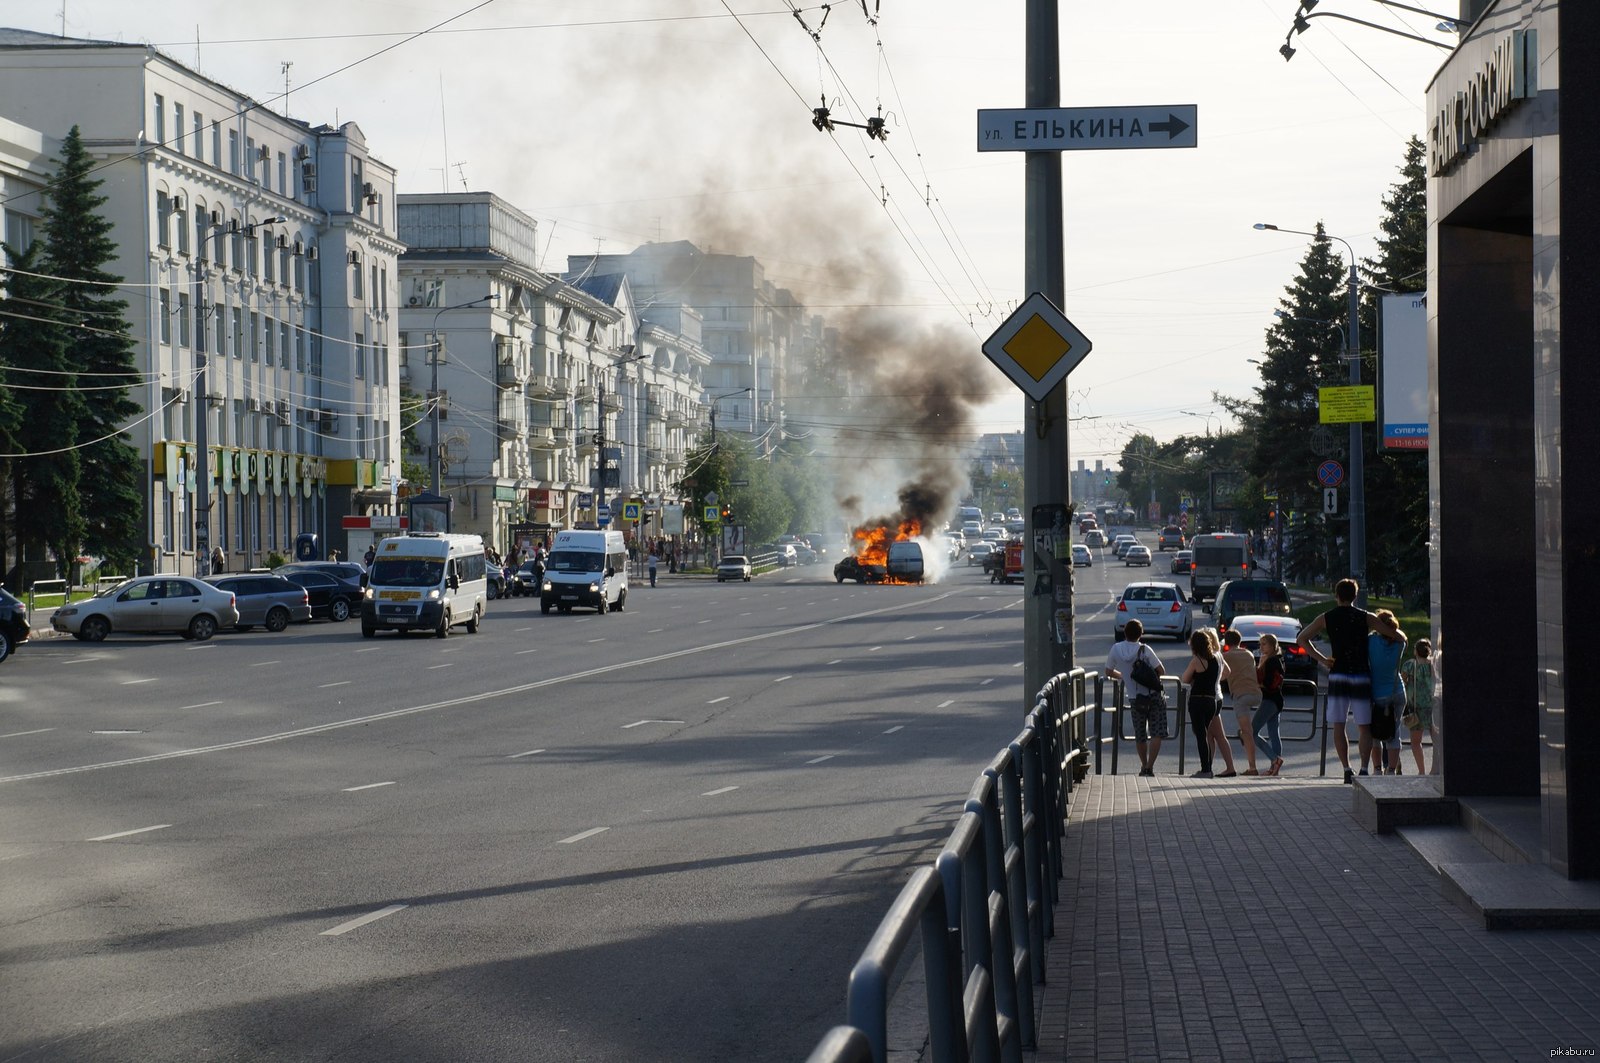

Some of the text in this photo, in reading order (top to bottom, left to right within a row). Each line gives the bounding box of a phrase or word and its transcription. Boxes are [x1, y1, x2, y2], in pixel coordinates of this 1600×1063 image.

[1431, 30, 1518, 177] БАНК РОССИИ
[1014, 117, 1144, 140] ЕЛЬКИНА
[1395, 439, 1413, 447] 11-16
